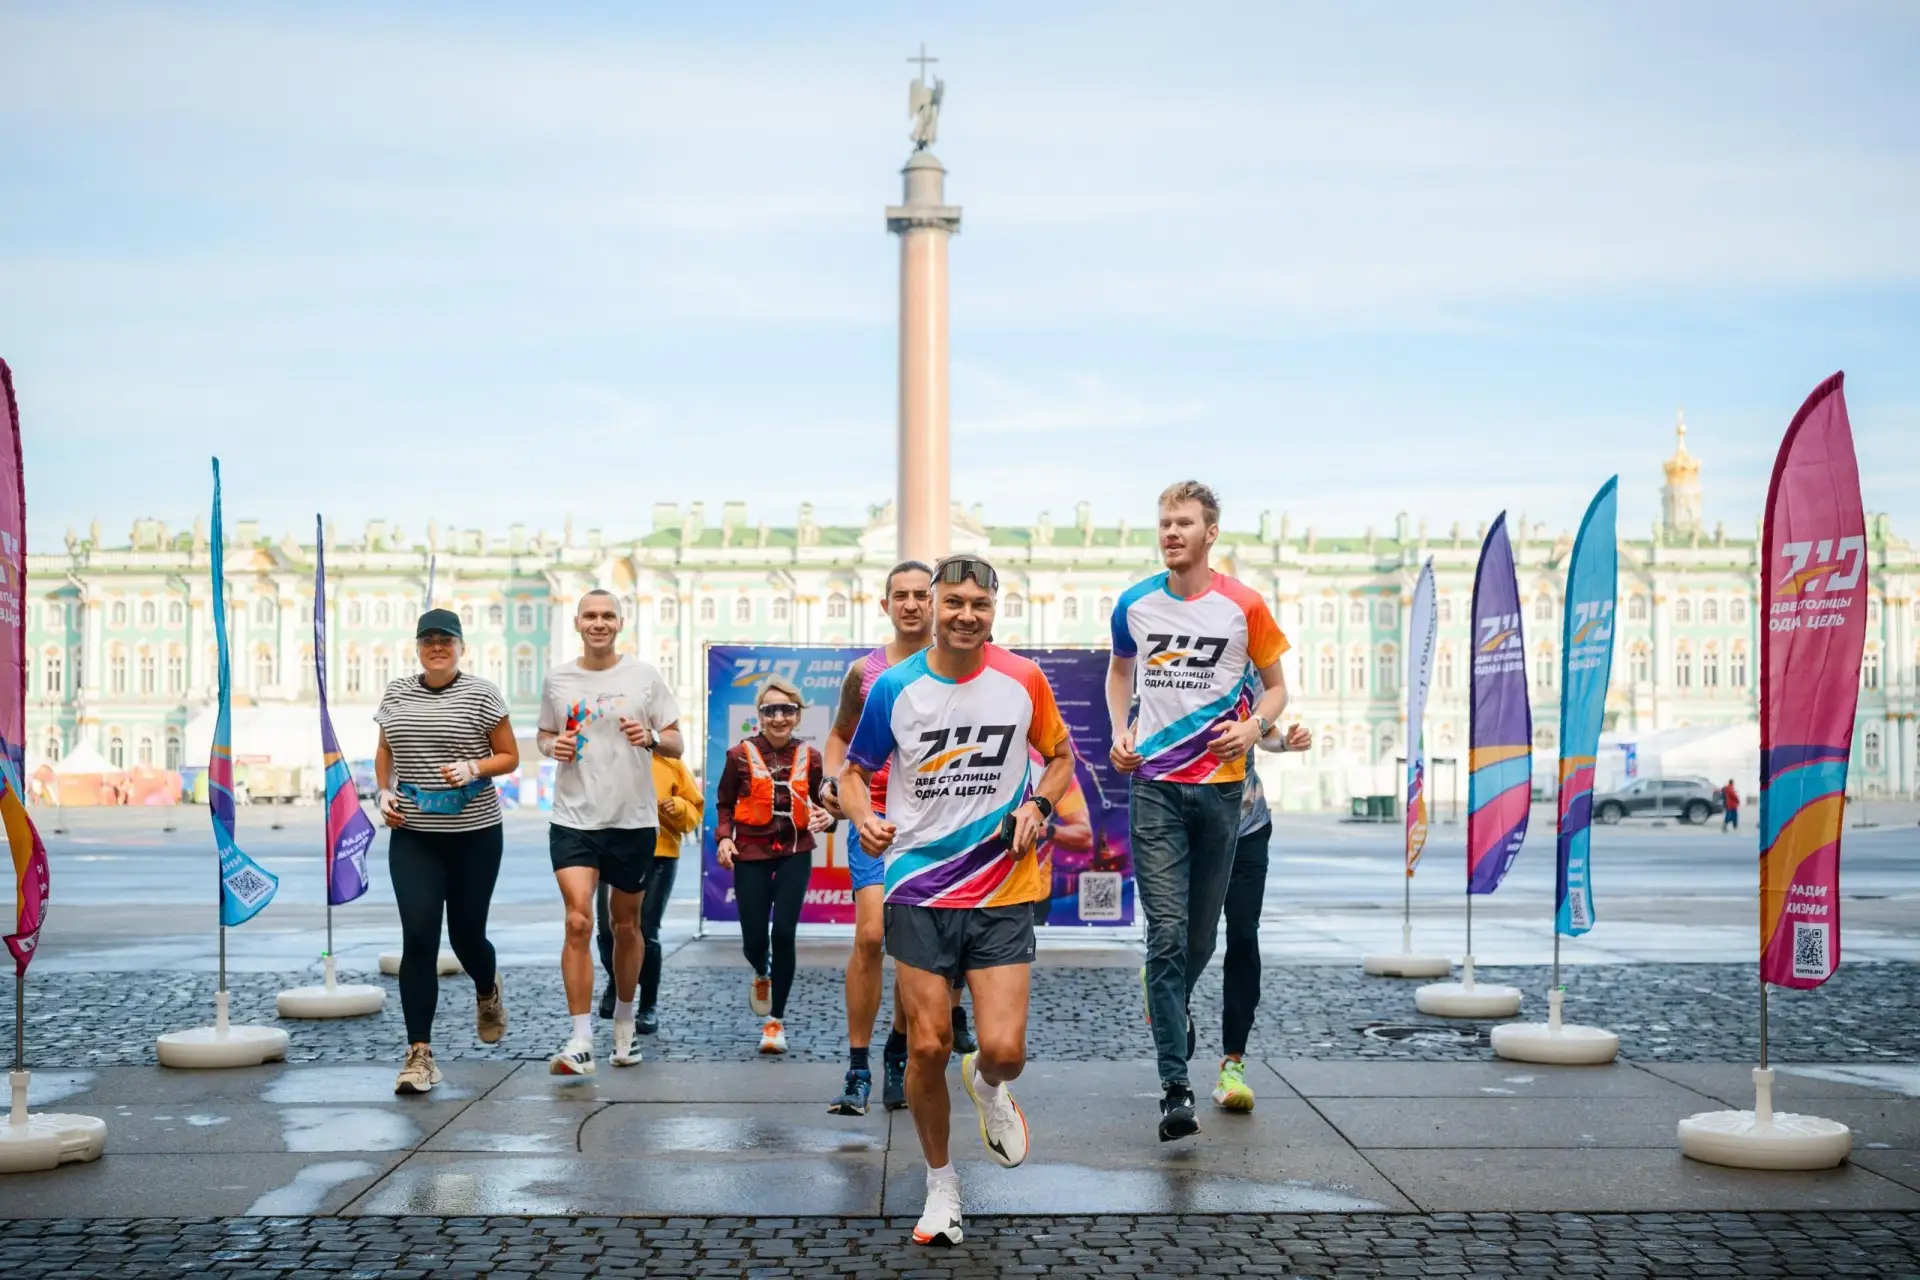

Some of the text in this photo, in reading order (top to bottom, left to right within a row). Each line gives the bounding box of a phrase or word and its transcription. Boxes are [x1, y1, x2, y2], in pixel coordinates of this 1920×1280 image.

[1769, 597, 1852, 614] ДВЕ ТОЛИЦЫ
[1806, 614, 1846, 630] ЦЕЛЬ
[806, 660, 845, 673] ДВЕ
[1144, 669, 1215, 679] ДВЕ СТОЛИЦЫ
[802, 676, 842, 689] ОДН
[1144, 679, 1212, 690] ОДНА ЦЕЛЬ
[914, 772, 1002, 787] ДВЕ СТОЛИЦЫ
[914, 785, 997, 801] ОДНА ЦЕЛЬ
[803, 889, 853, 904] ЖИЗ
[1791, 884, 1828, 898] РАДИ
